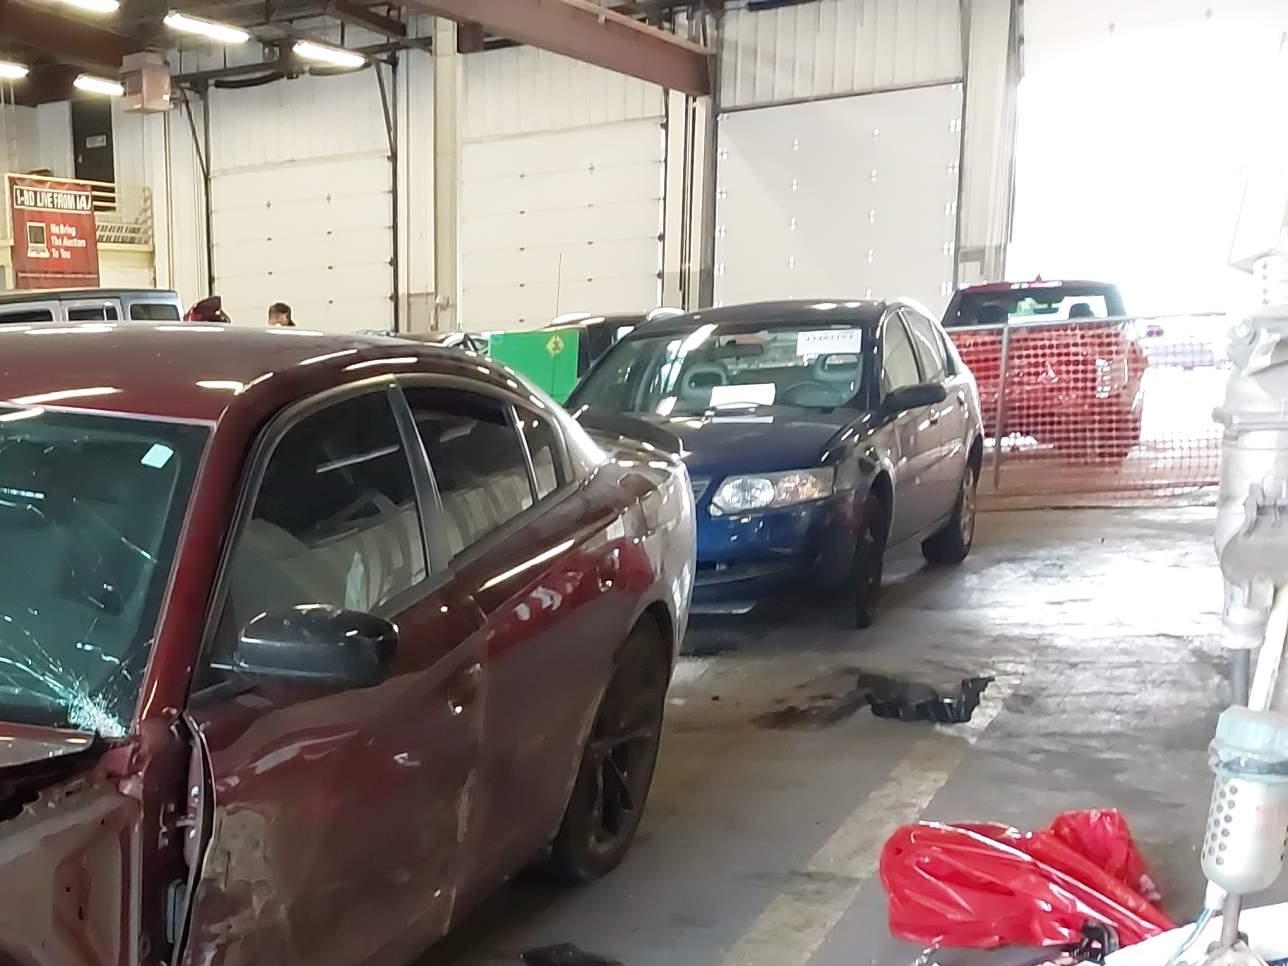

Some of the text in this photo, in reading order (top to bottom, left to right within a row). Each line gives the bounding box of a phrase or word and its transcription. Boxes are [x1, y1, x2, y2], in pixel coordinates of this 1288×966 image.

[53, 192, 76, 210] FROM
[60, 224, 76, 237] Bring
[51, 235, 62, 246] The
[51, 248, 71, 259] To You
